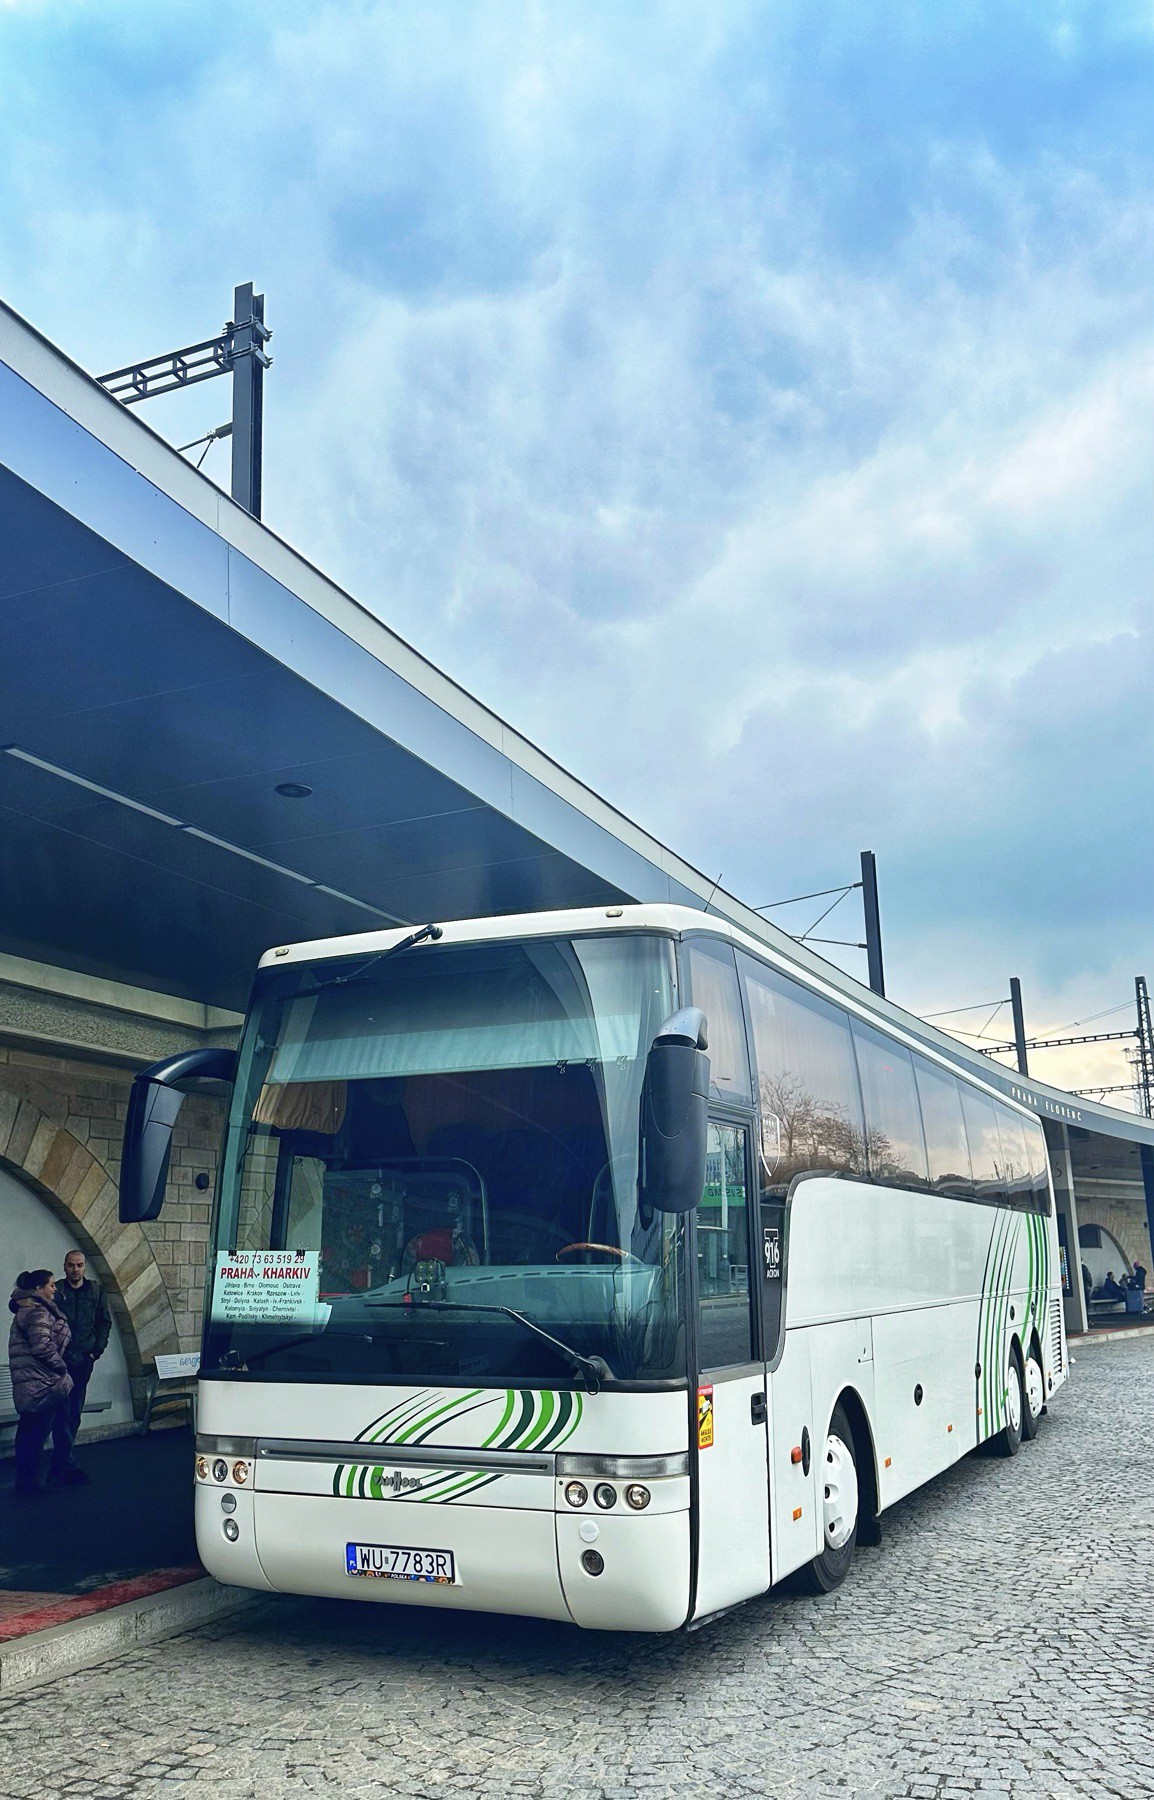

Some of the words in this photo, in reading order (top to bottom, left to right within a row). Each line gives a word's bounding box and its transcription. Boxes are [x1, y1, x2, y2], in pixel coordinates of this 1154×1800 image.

[1011, 1086, 1038, 1106] PRAHA
[1045, 1101, 1082, 1121] FLORENC
[229, 1254, 249, 1264] +420
[263, 1254, 274, 1264] 63
[277, 1254, 292, 1264] 519
[294, 1254, 305, 1264] 29
[220, 1267, 254, 1279] PRAHA
[262, 1267, 311, 1279] KHARKIV
[360, 1548, 383, 1570] WU
[390, 1551, 447, 1576] 7783R
